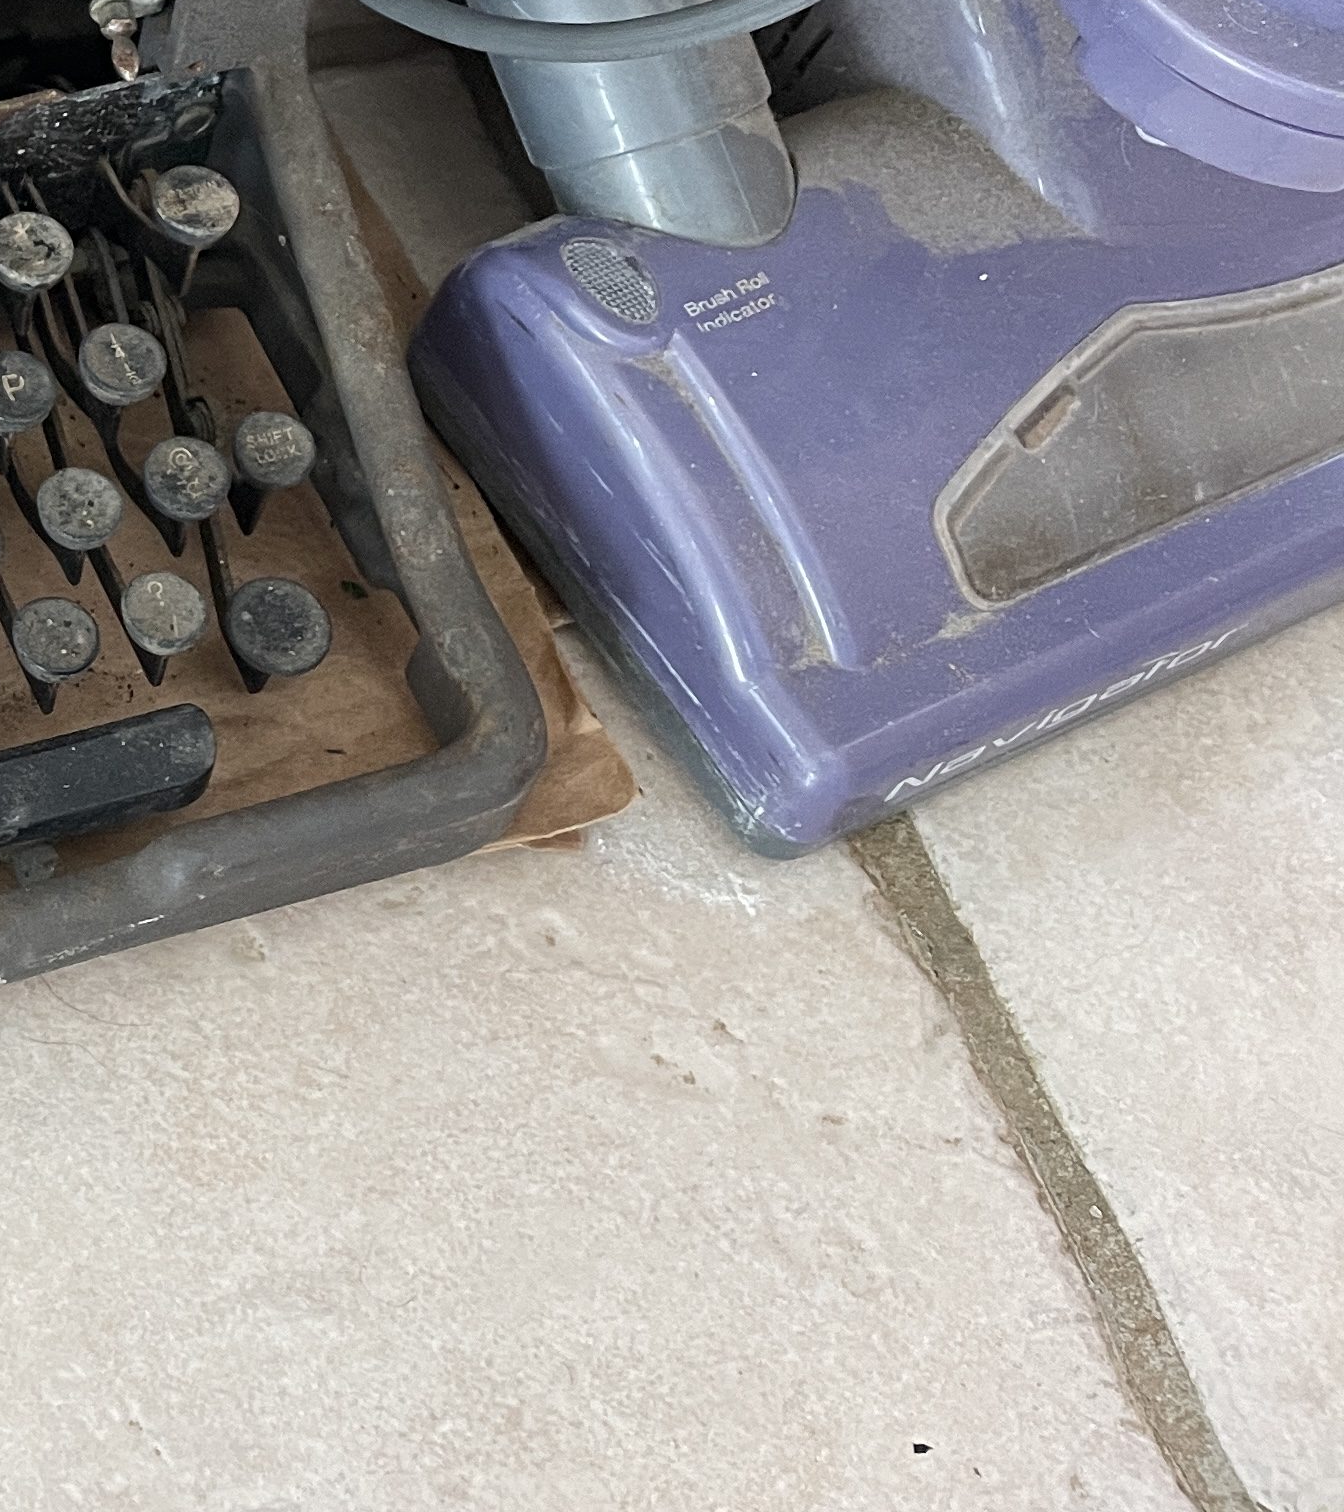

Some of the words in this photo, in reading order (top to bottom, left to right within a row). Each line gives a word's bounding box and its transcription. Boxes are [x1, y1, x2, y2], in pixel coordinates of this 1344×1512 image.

[683, 288, 739, 317] Brush
[735, 271, 770, 295] Roll
[696, 292, 777, 332] Indicator
[1, 373, 25, 402] P
[245, 426, 294, 450] SHIFT
[883, 622, 1250, 804] Navigator
